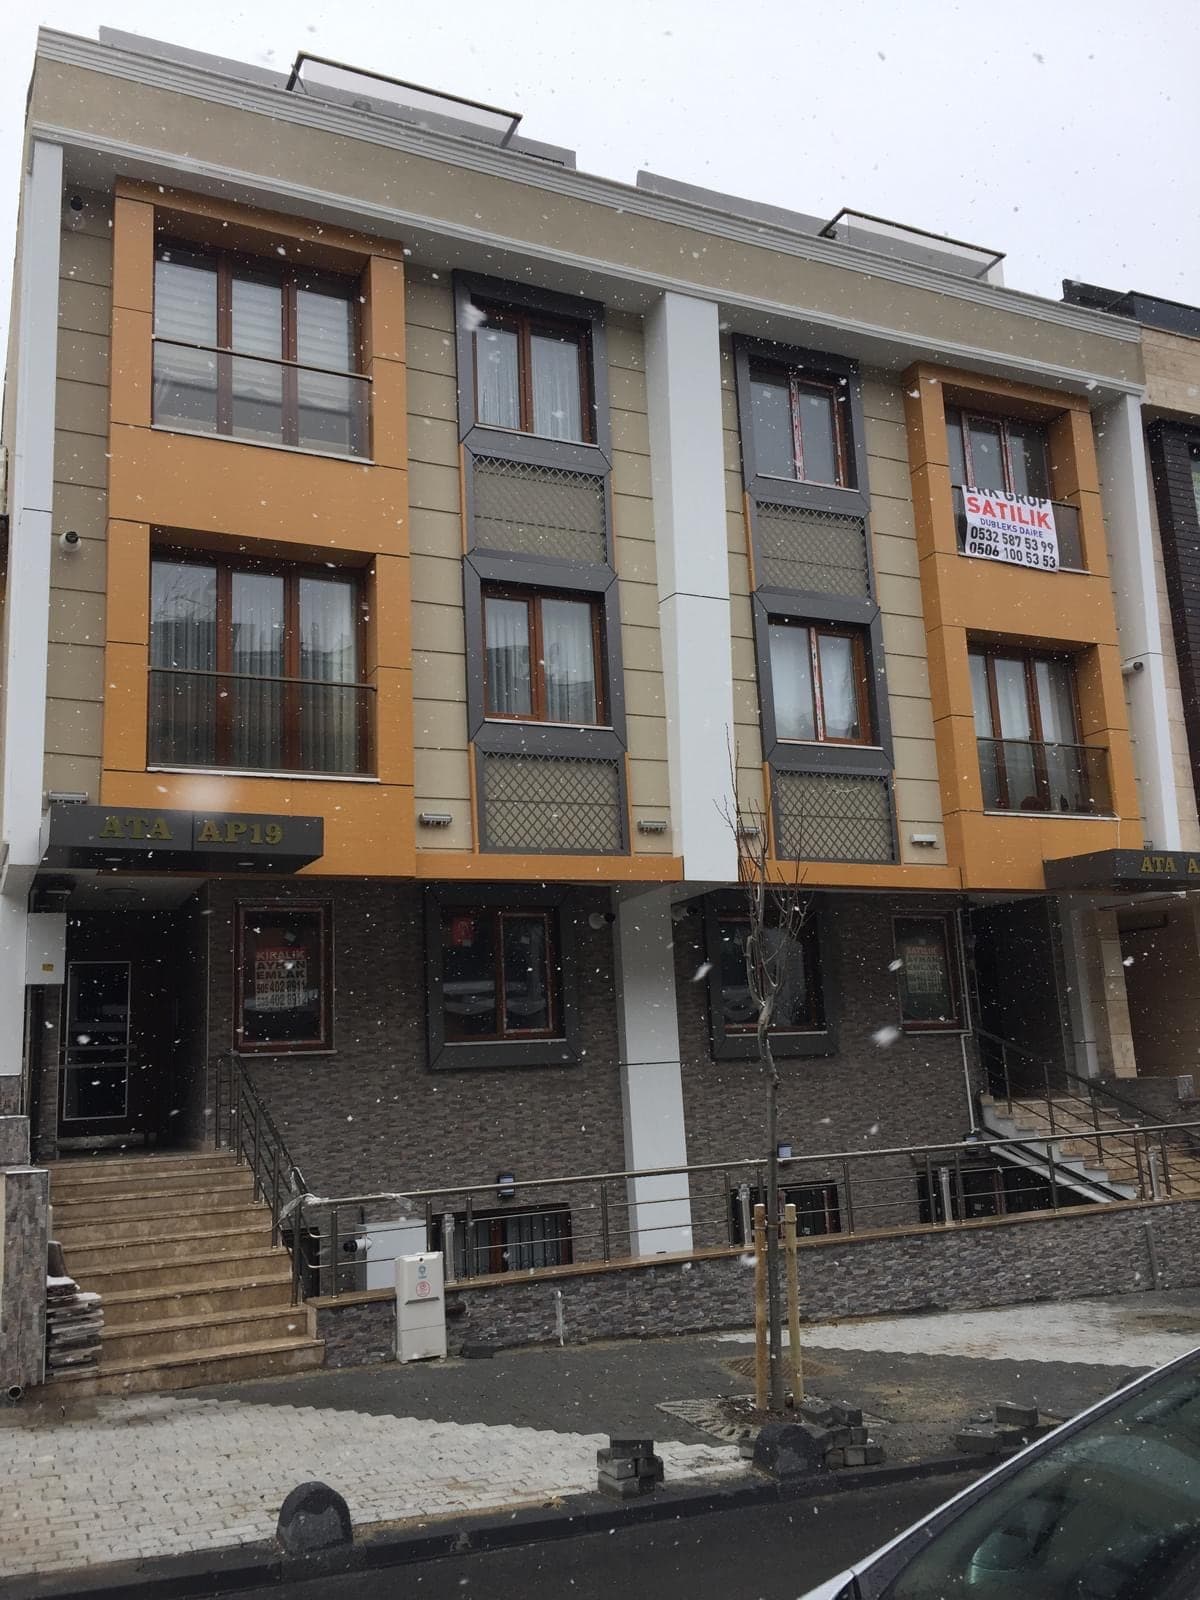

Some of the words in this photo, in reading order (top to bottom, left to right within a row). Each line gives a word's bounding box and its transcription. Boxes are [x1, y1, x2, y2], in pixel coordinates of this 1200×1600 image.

[967, 495, 1052, 530] SATILIK
[1004, 491, 1047, 509] GRUP
[971, 526, 999, 543] 0532
[1002, 533, 1021, 547] 587
[1025, 537, 1038, 551] 53
[1041, 541, 1054, 554] 99
[970, 541, 999, 557] 0506
[1004, 547, 1022, 561] 100
[1026, 551, 1039, 565] 53
[1043, 555, 1056, 568] 53
[100, 815, 173, 840] ATA
[198, 819, 283, 845] AP19
[1141, 856, 1178, 873] ATA
